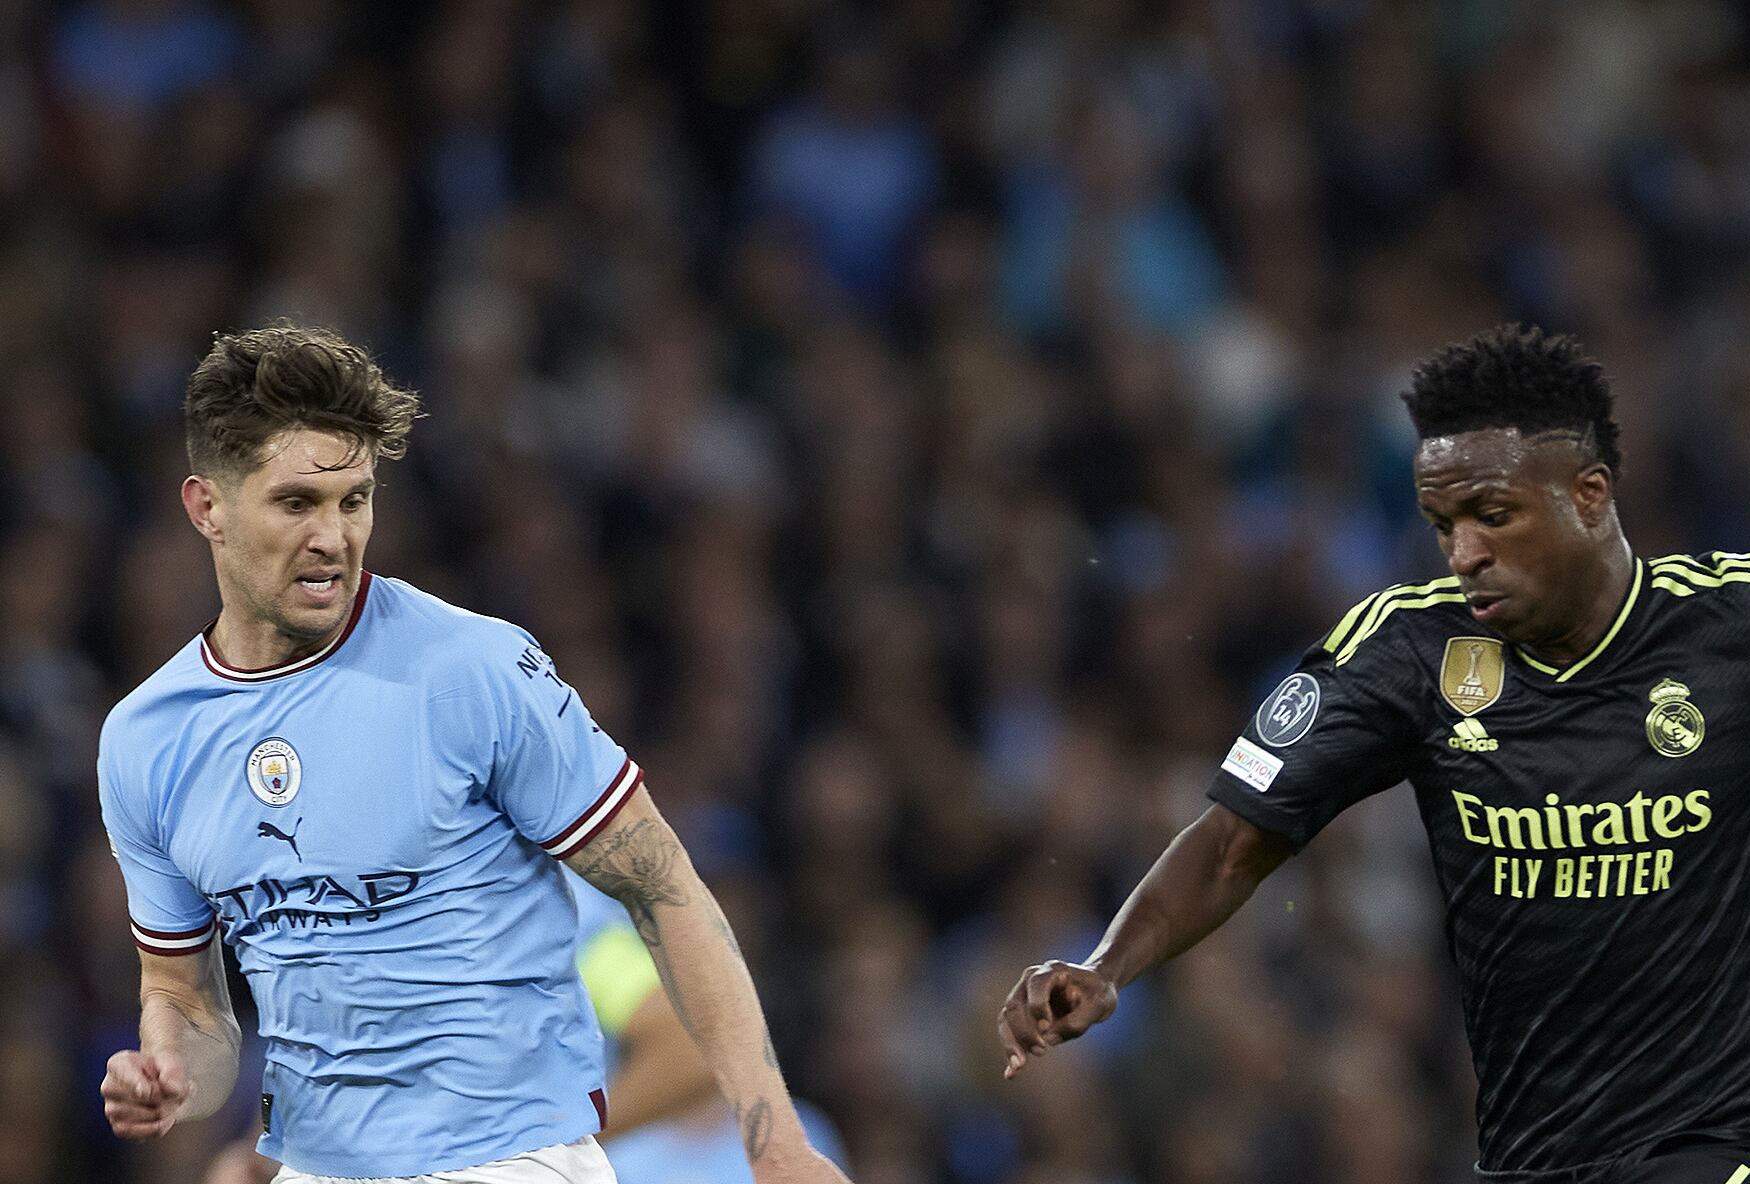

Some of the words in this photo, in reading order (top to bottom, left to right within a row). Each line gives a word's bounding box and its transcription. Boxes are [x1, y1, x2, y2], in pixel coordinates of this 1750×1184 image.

[1456, 685, 1485, 697] FIFA
[1272, 704, 1292, 727] 14
[1451, 789, 1712, 850] Emirates
[1494, 856, 1543, 899] FLY
[1554, 849, 1674, 898] BETTER
